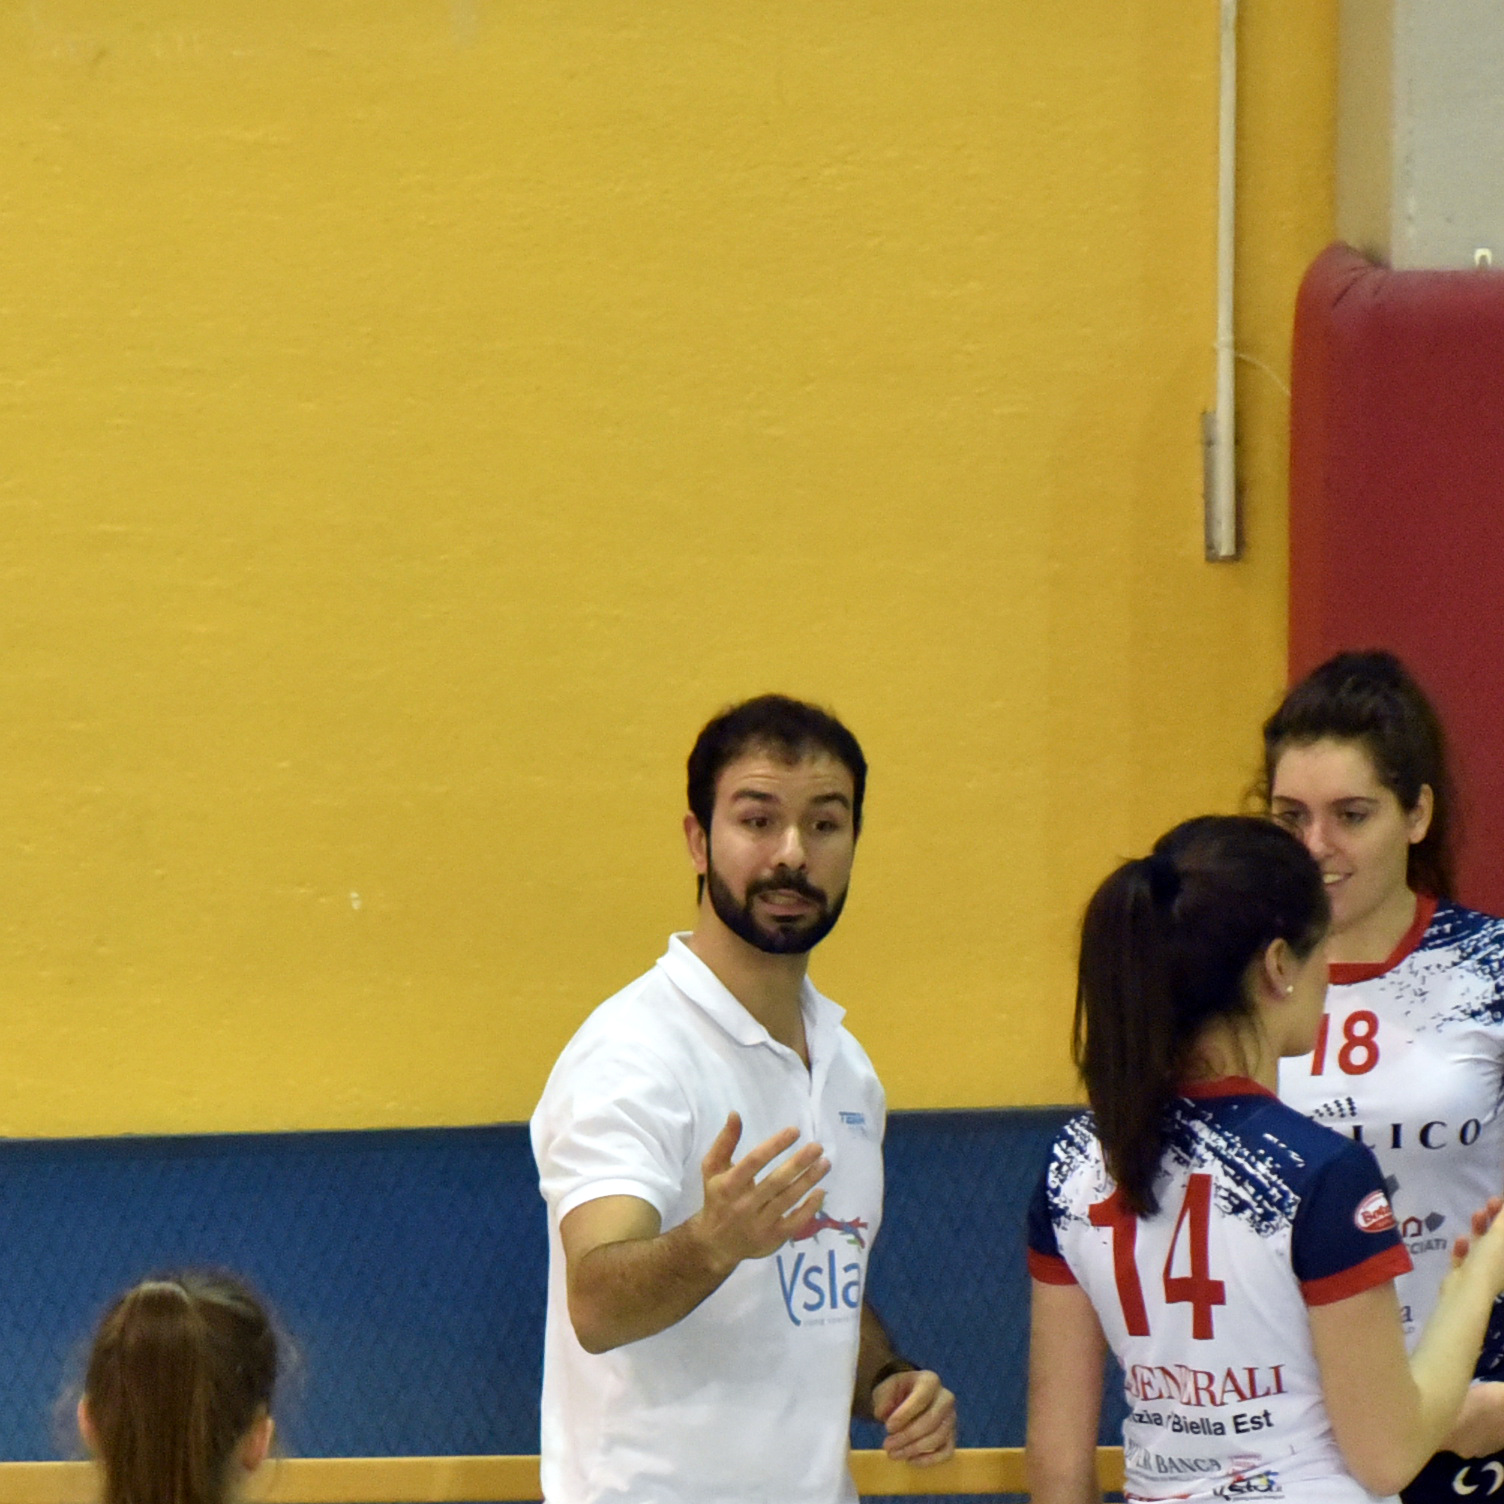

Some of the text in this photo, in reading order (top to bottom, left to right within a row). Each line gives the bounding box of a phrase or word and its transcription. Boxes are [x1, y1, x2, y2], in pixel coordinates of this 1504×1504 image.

[1352, 1118, 1481, 1150] LICO
[1089, 1173, 1226, 1340] 14
[776, 1250, 861, 1326] Ysla
[1171, 1413, 1226, 1436] Biella
[1233, 1409, 1274, 1434] Est
